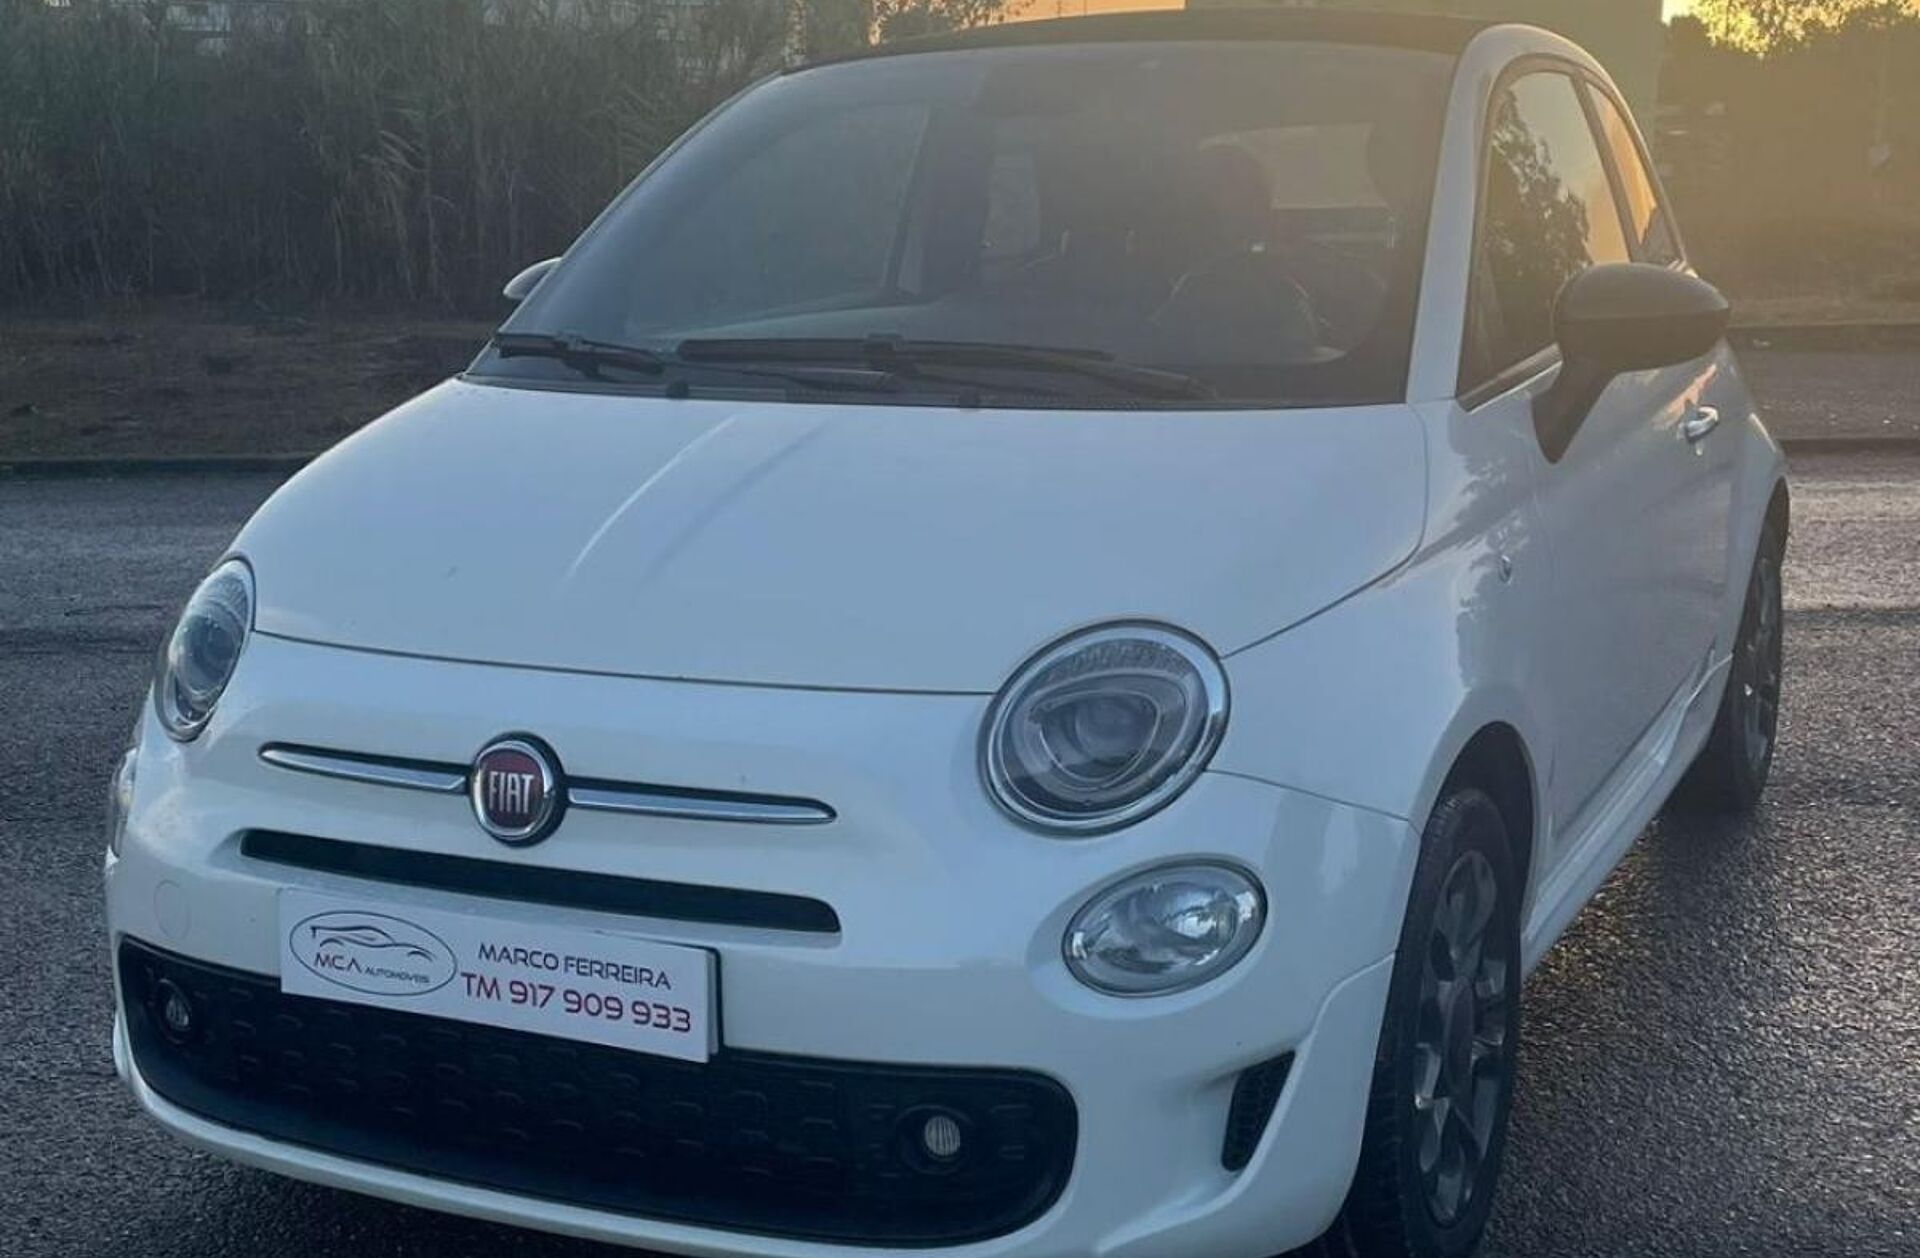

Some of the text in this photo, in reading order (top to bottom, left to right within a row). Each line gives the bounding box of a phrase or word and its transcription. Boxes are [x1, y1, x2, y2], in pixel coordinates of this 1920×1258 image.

[488, 771, 535, 813] FIAT
[314, 952, 362, 974] MCA
[478, 943, 672, 990] MARCO FERREIRA
[460, 972, 691, 1033] TM 917 909 933
